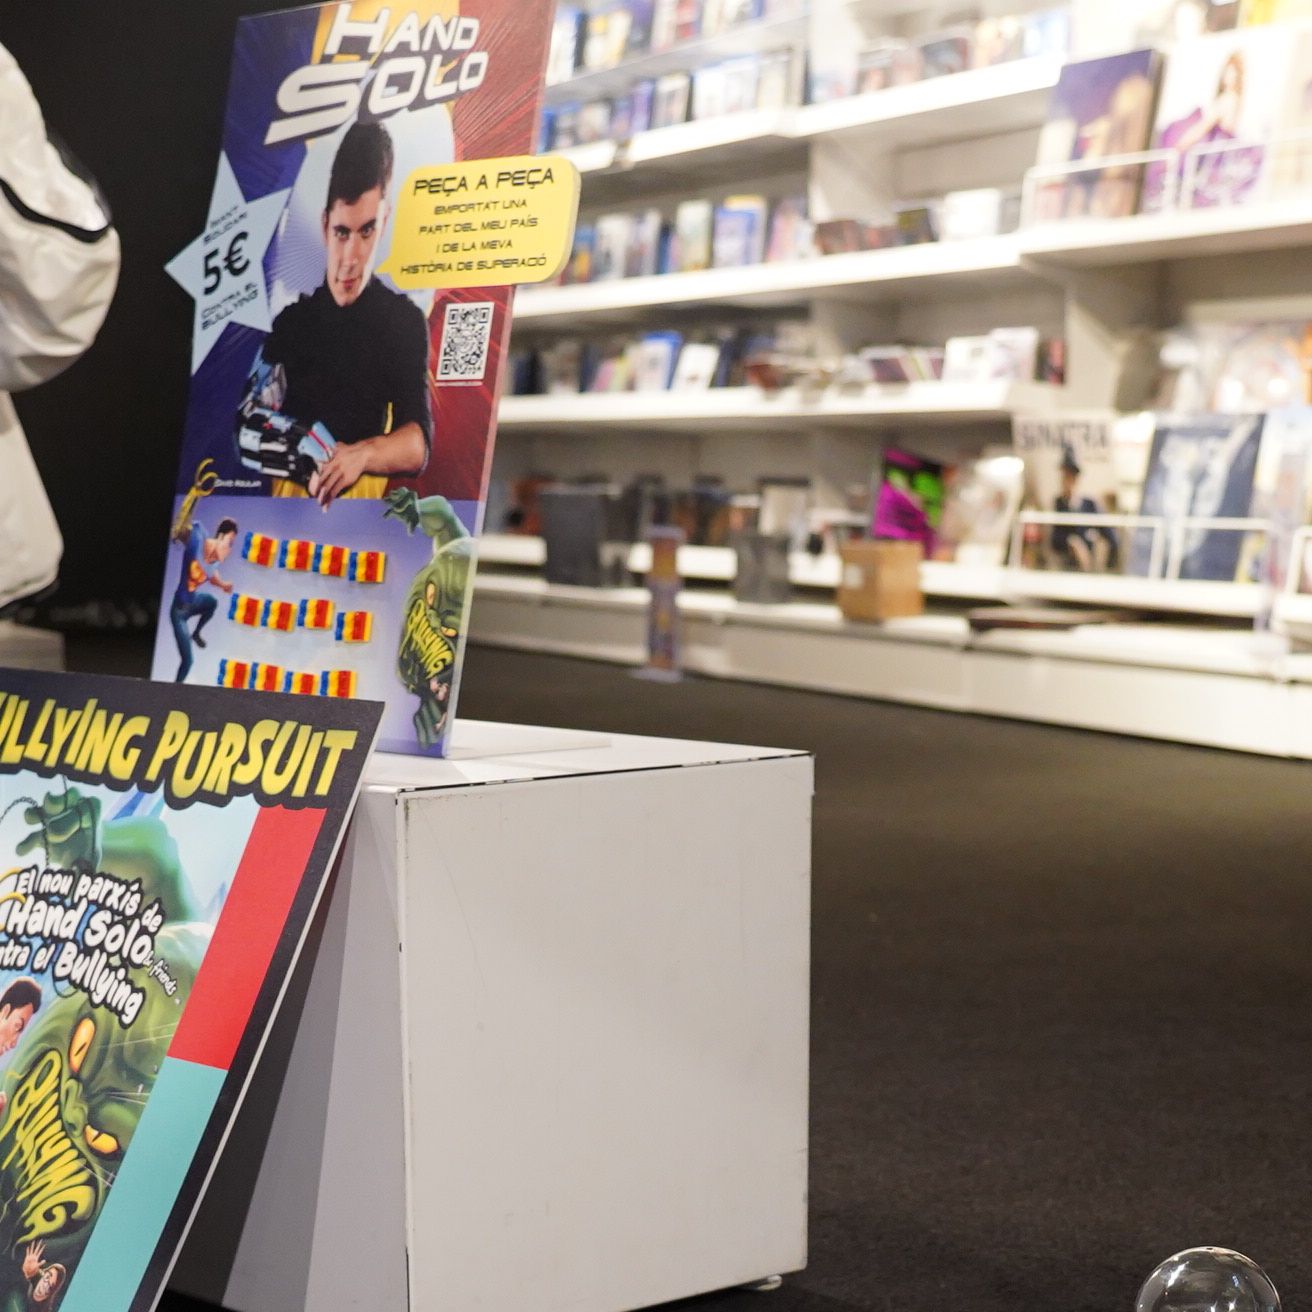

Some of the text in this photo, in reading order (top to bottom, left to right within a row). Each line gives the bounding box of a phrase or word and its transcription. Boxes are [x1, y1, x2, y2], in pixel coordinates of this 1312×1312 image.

[324, 4, 480, 54] HAND
[264, 51, 488, 145] SOLO
[413, 167, 555, 197] PEÇA A PEÇA
[502, 199, 528, 210] UNA
[418, 214, 539, 235] PART DEL MEU PAÍS
[442, 242, 459, 253] DE
[461, 241, 477, 251] LA
[480, 240, 514, 250] MEVA
[204, 231, 250, 295] 5€
[456, 261, 474, 272] DE
[407, 599, 455, 676] BULLYING
[144, 710, 359, 799] PURSUIT
[6, 897, 88, 940] Hand
[84, 910, 153, 965] Solo
[16, 866, 163, 933] El nou parxís de
[32, 943, 56, 971] el
[55, 941, 144, 1026] Bullying
[14, 1050, 98, 1242] BULLYING
